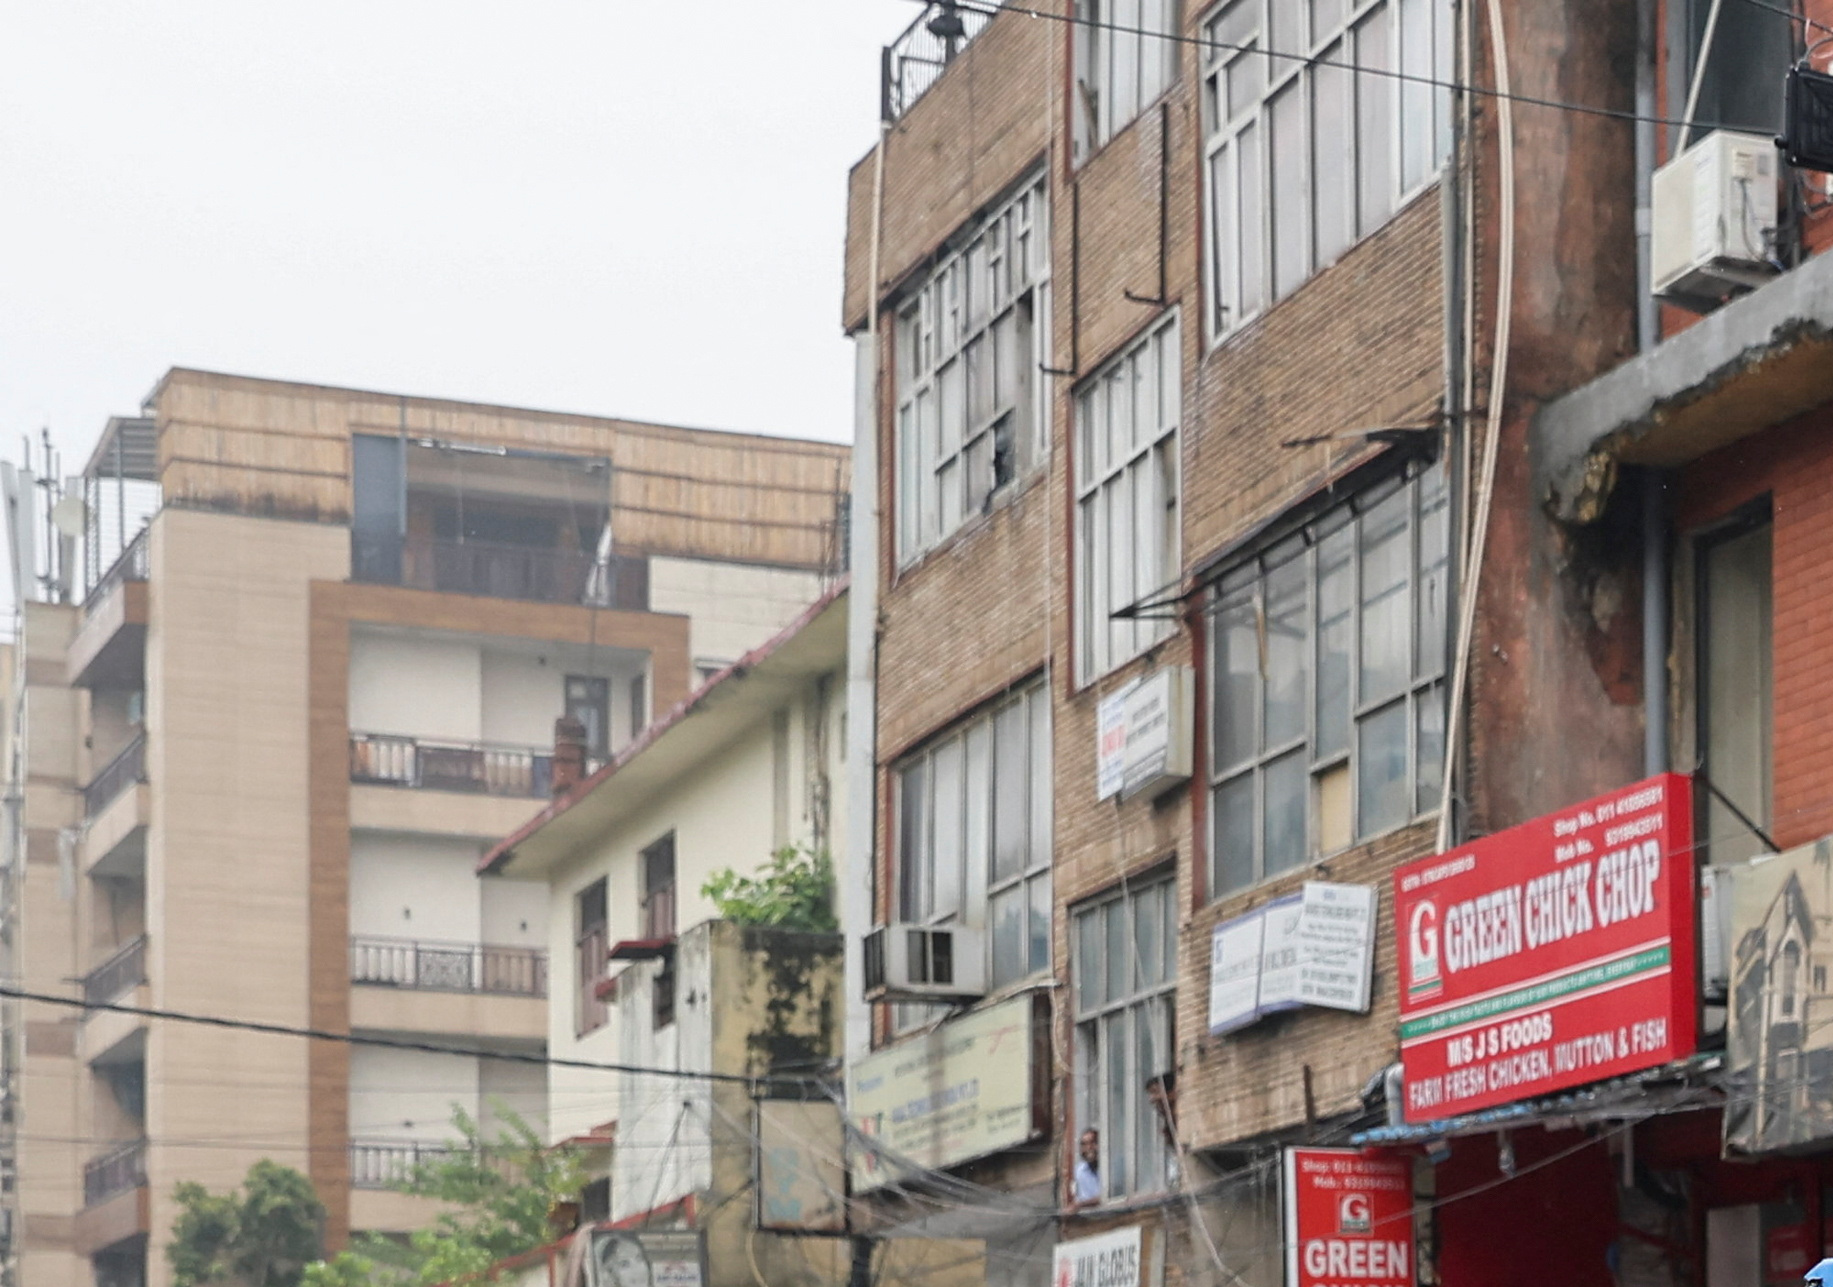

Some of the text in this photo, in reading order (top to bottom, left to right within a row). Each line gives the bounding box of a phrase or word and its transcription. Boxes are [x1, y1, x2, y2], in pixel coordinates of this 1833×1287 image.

[1444, 884, 1522, 974] GREEN
[1524, 861, 1594, 950] CHICK
[1595, 837, 1661, 928] CHOP
[1409, 1016, 1668, 1112] FARM FRESH CHICKEN, MUTTON & FISH
[1487, 1026, 1500, 1057] S
[1500, 1010, 1553, 1054] FOODS
[1304, 1239, 1409, 1279] GREEN
